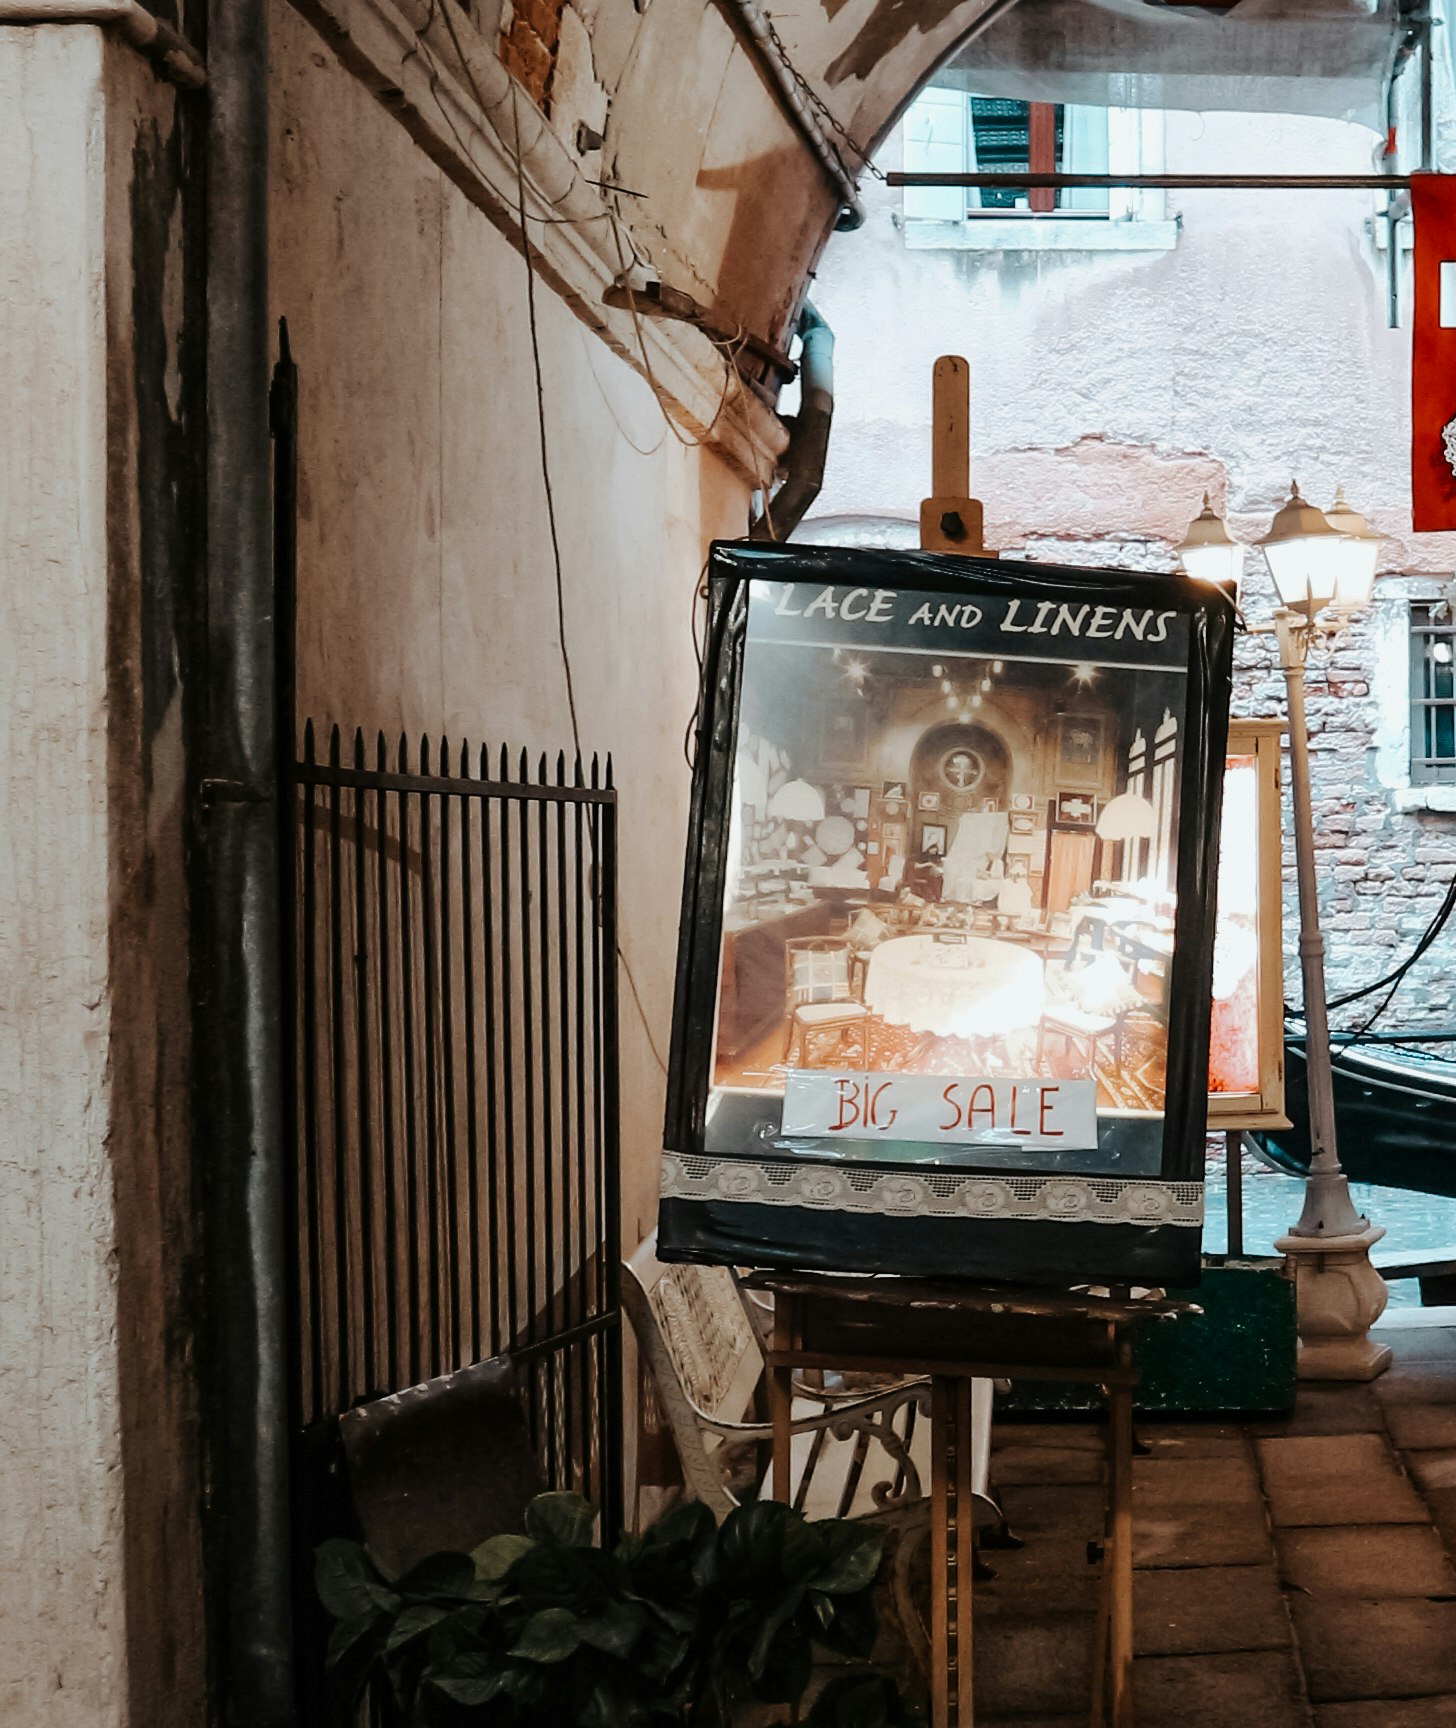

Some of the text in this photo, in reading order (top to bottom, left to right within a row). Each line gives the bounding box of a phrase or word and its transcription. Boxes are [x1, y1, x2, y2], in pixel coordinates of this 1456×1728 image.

[773, 583, 1177, 643] LACE AND LINENS
[939, 1082, 1065, 1137] SALE
